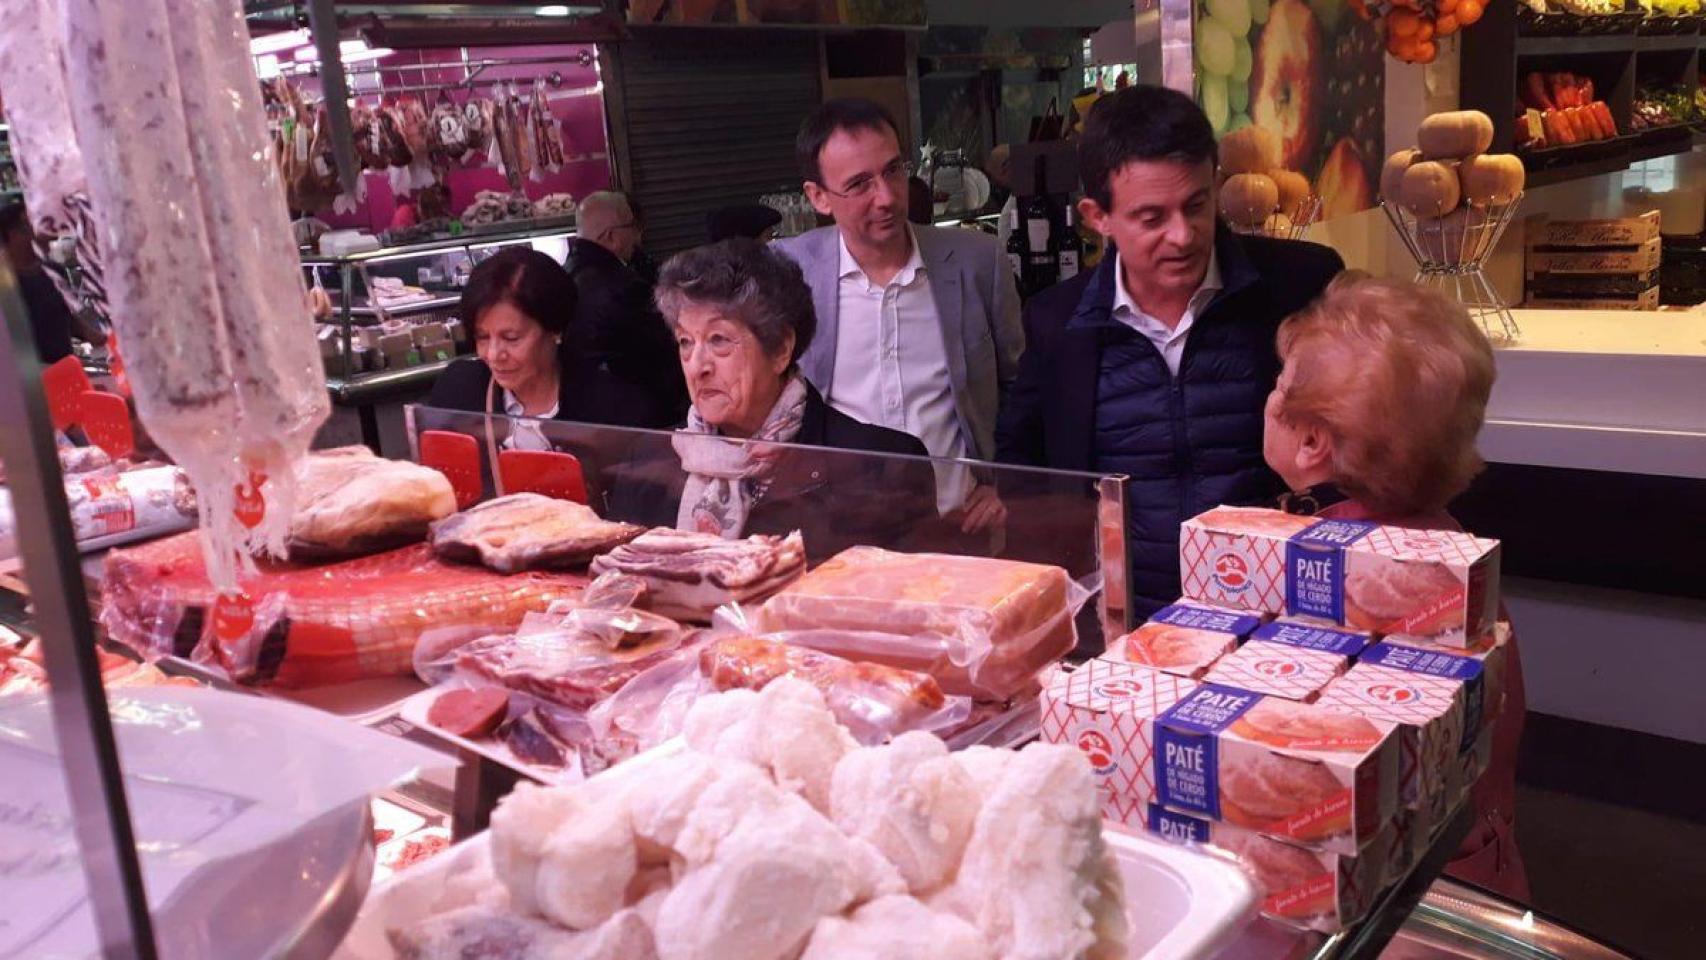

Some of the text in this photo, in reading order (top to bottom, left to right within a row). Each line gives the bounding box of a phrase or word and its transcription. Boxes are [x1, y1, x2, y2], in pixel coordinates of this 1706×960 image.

[1297, 558, 1332, 582] PATÉ
[1297, 579, 1305, 589] DE
[1297, 589, 1332, 603] DE CERDO
[1192, 690, 1251, 711] PATÉ
[1166, 742, 1205, 772] PATÉ
[1160, 817, 1196, 841] PATÉ
